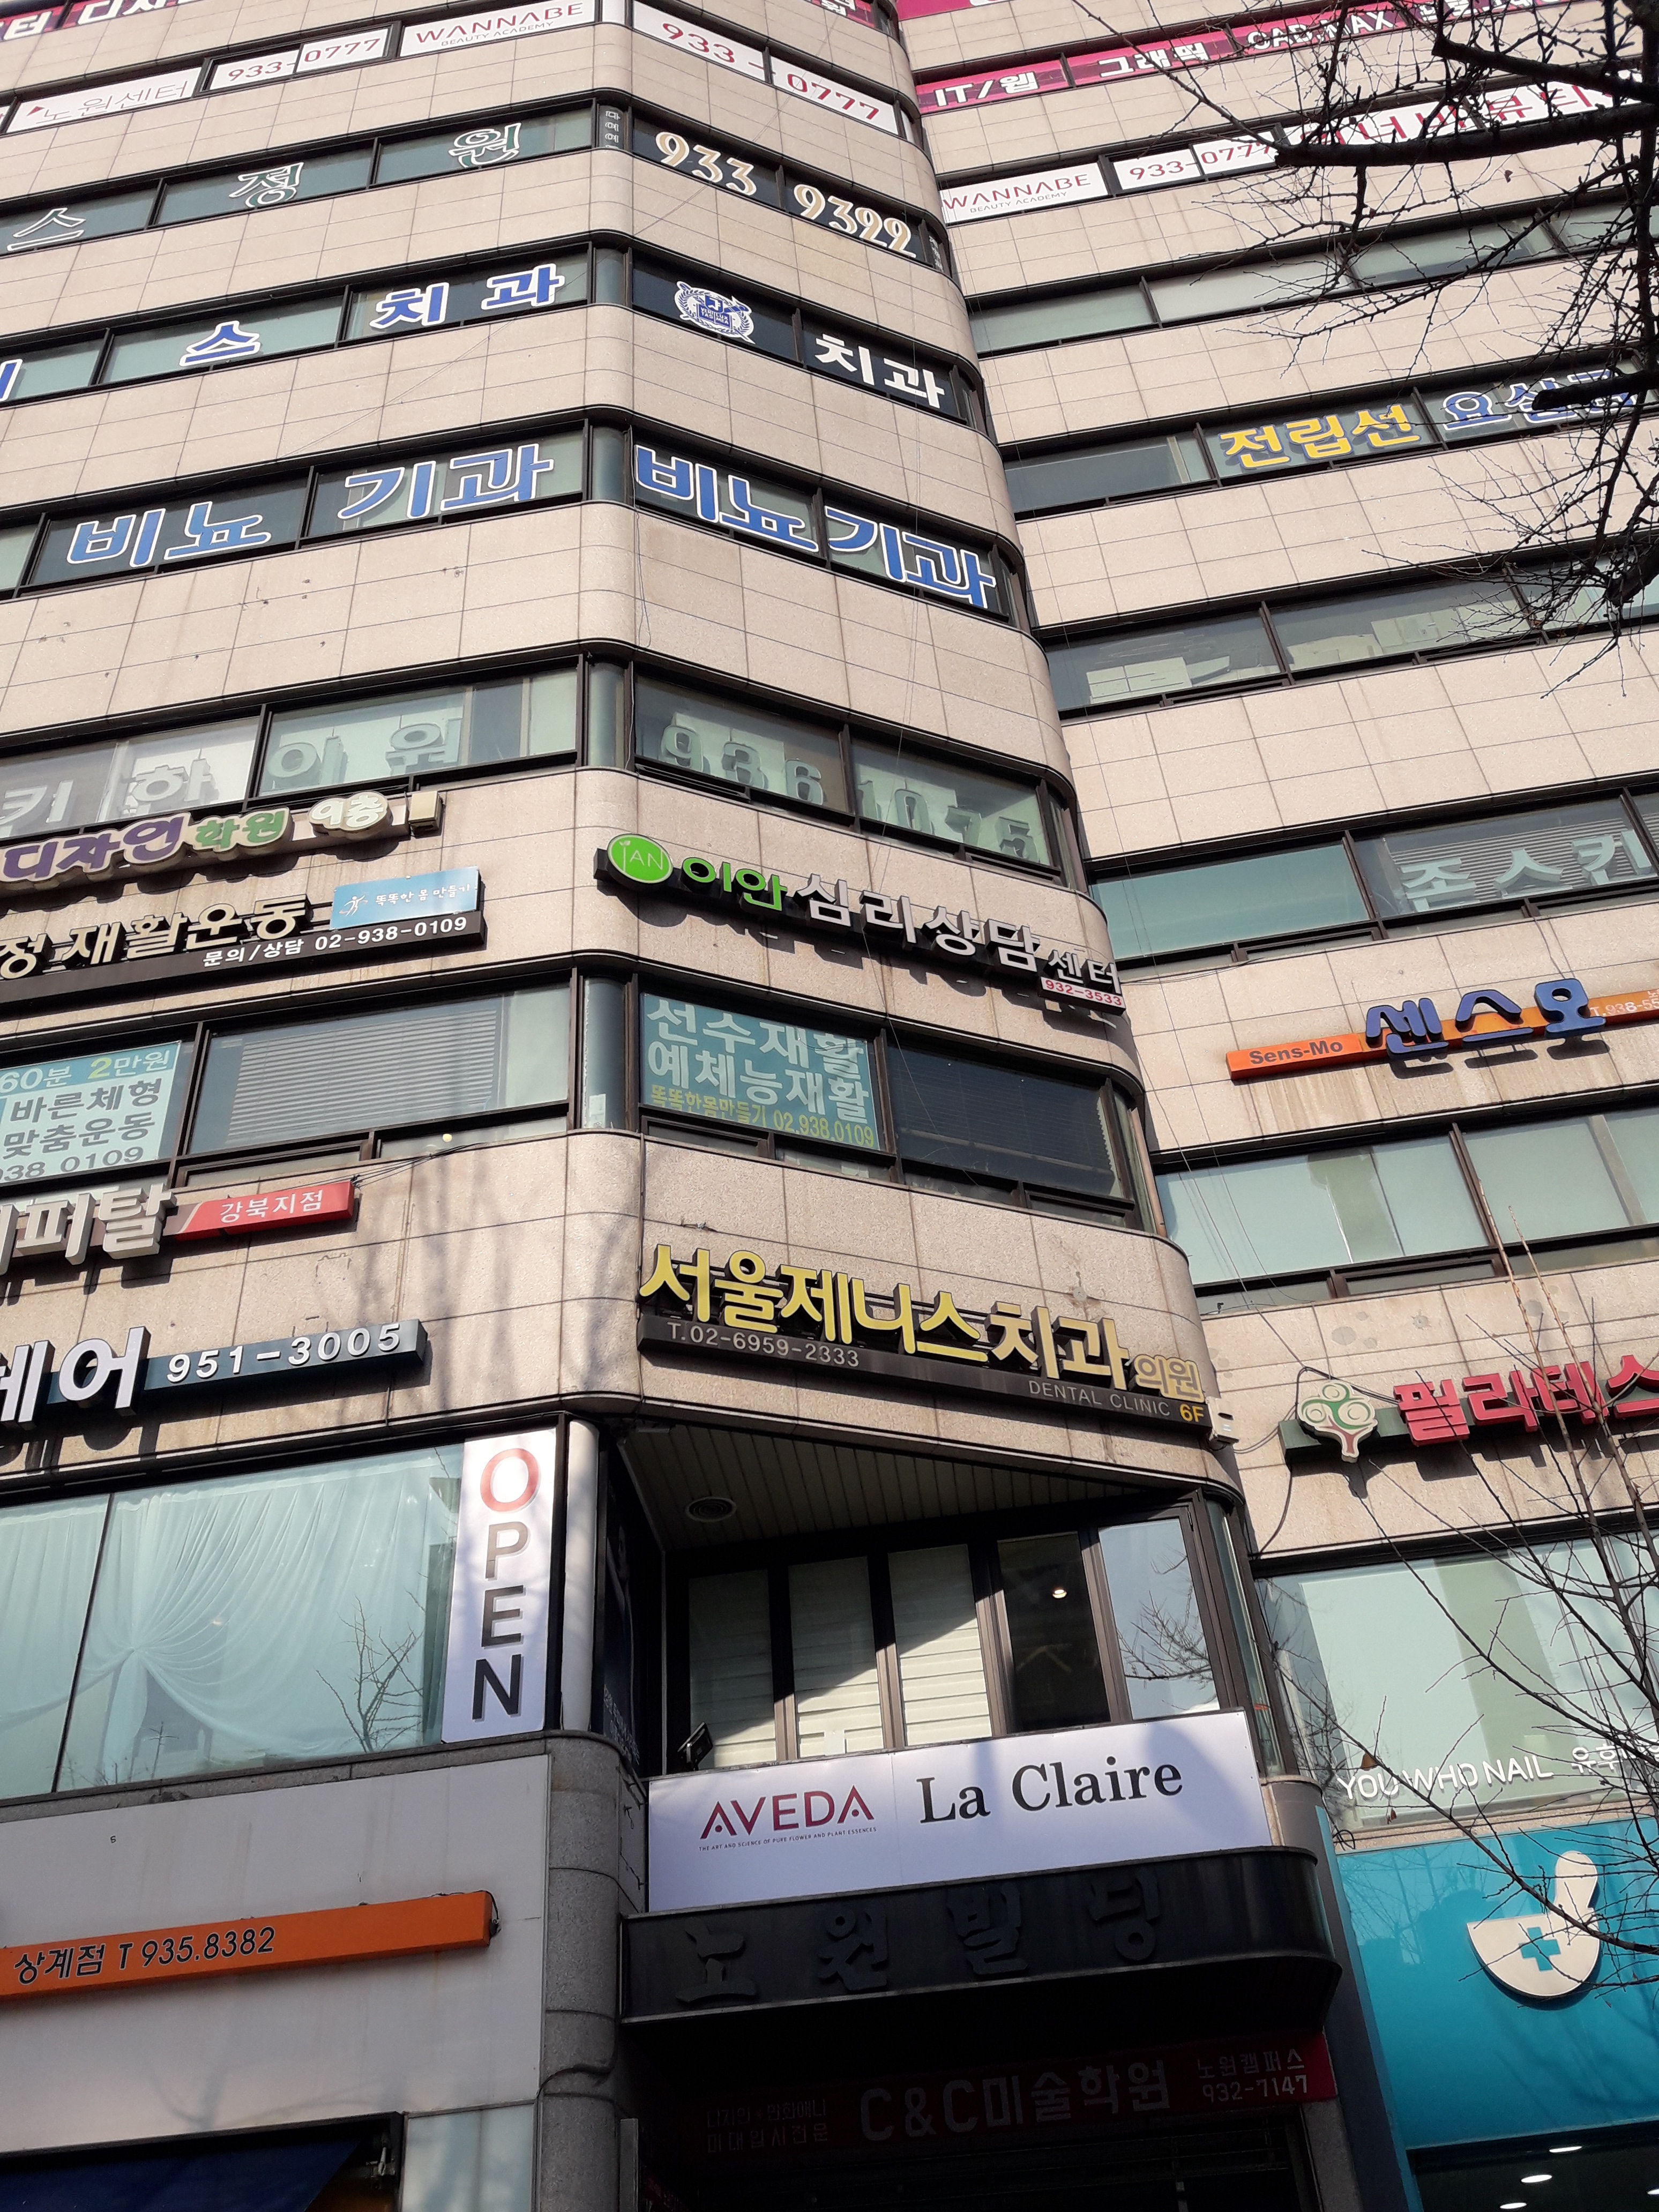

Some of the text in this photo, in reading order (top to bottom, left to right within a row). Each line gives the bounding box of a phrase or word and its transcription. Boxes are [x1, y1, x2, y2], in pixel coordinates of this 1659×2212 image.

[416, 2, 583, 44] WANNABE
[441, 21, 554, 47] BEAUTY ACADEMY
[228, 39, 381, 81] 933-0777
[935, 71, 1040, 107] IT/웹
[1098, 42, 1210, 78] 그래픽
[36, 81, 188, 124] 노원센터
[656, 131, 757, 197] 933
[794, 184, 916, 258] 9322
[942, 174, 1092, 210] WANNABE
[969, 191, 1067, 213] BEAUTY ACADEMY
[370, 263, 564, 328] 치과
[816, 334, 944, 408] 치과
[1219, 404, 1422, 469] 전립선
[661, 725, 824, 806] 936
[4, 816, 183, 879] 디자인
[196, 809, 287, 849] 학원
[376, 884, 470, 906] 똑똑한 몸 만들기
[683, 857, 787, 911] 이안
[62, 894, 307, 965] 재활운동
[203, 917, 467, 967] 문의/상담 02-938-0109
[1045, 980, 1122, 1006] 932-3533
[647, 999, 864, 1080] 선수재활
[1249, 1040, 1343, 1066] Sens-Mo
[0, 1050, 169, 1093] 60분 2만원
[648, 1041, 869, 1124] 예체능재활
[10, 1078, 162, 1123] 바른체형
[3, 1112, 155, 1159] 맞춤운동
[774, 1110, 874, 1148] 02.938.0109
[0, 1147, 144, 1180] 38 0109
[0, 1183, 323, 1274] 피탈 강북지점
[167, 1324, 400, 1382] 951-3005
[667, 1322, 1204, 1423] T.02-6959-2333 DENTAL CLINIC 6F
[1135, 1355, 1204, 1402] 의원
[472, 1448, 540, 1720] OPEN
[700, 1757, 1183, 1840] AVEDA La Claire
[1338, 1770, 1400, 1799] YOU
[1402, 1762, 1477, 1791] WHO
[1483, 1755, 1553, 1787] NAIL
[848, 1827, 877, 1835] ESSENCES
[14, 1926, 275, 1985] 상계점 T 935.8382
[1203, 2074, 1307, 2104] 932-7147
